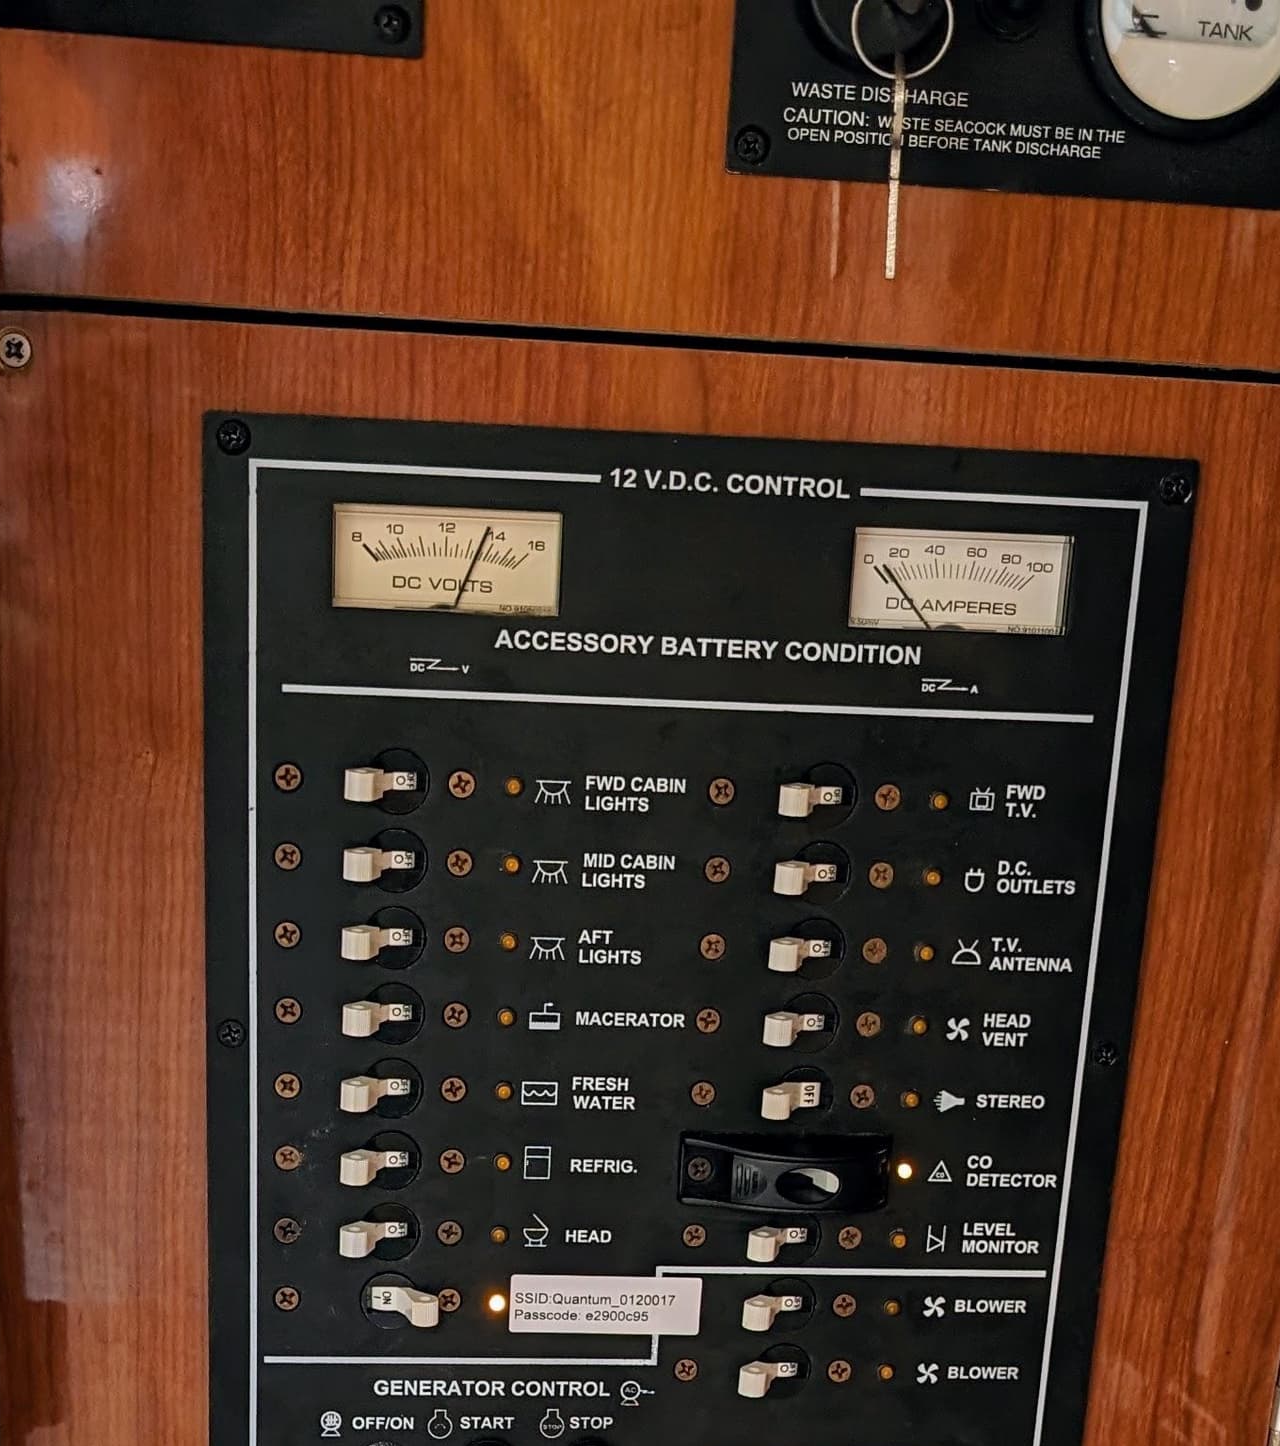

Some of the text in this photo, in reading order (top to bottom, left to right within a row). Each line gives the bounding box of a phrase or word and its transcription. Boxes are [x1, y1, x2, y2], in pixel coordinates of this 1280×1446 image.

[1198, 20, 1253, 41] TANK
[791, 81, 969, 107] WASTE DISHARGE
[783, 107, 869, 127] CAUTION:
[934, 119, 1006, 136] SEACOCK
[1010, 123, 1051, 139] MUST
[1055, 127, 1074, 141] BE
[1078, 129, 1093, 142] IN
[1096, 129, 1126, 143] THE
[787, 127, 830, 142] OPEN
[908, 135, 969, 151] BEFORE
[973, 138, 1014, 154] TANK
[1015, 141, 1102, 159] DISCHARGE
[609, 468, 851, 499] 12 V.D.C. CONTROL
[351, 522, 506, 543] 8 10 12 14
[863, 545, 1054, 574] 0 20 40 60 80 100
[392, 575, 494, 594] DC VOLTS
[885, 597, 1017, 616] DC AMPERES
[494, 628, 922, 667] ACCESSORY BATTERY CONDITION
[584, 774, 687, 796] FWD CABIN
[1005, 784, 1046, 802] FWD
[584, 796, 650, 813] LIGHTS
[1005, 802, 1037, 819] T.V.
[583, 852, 676, 871] MID CABIN
[998, 860, 1032, 877] D.C.
[581, 872, 646, 890] LIGHTS
[996, 878, 1076, 896] OUTLETS
[578, 929, 613, 946] AFT
[991, 937, 1022, 954] T.V.
[578, 948, 642, 965] LIGHTS
[989, 956, 1073, 973] ANTENNA
[575, 1010, 686, 1029] MACERATOR
[982, 1012, 1031, 1029] HEAD
[981, 1031, 1028, 1048] VENT
[571, 1075, 630, 1093] FRESH
[572, 1093, 636, 1111] WATER
[975, 1093, 1046, 1110] STEREO
[569, 1158, 638, 1174] REFRIG.
[966, 1154, 993, 1170] CO
[965, 1172, 1057, 1189] DETECTOR
[564, 1228, 612, 1245] HEAD
[962, 1221, 1017, 1238] LEVEL
[961, 1238, 1040, 1255] MONITOR
[514, 1291, 677, 1308] SSID:Quantum_0120017
[953, 1298, 1027, 1315] BLOWER
[514, 1308, 650, 1322] Passcode: e2900c95
[947, 1364, 1019, 1381] BLOWER
[373, 1379, 610, 1398] GENERATOR CONTROL
[351, 1415, 614, 1431] OFF/ON START STOP
